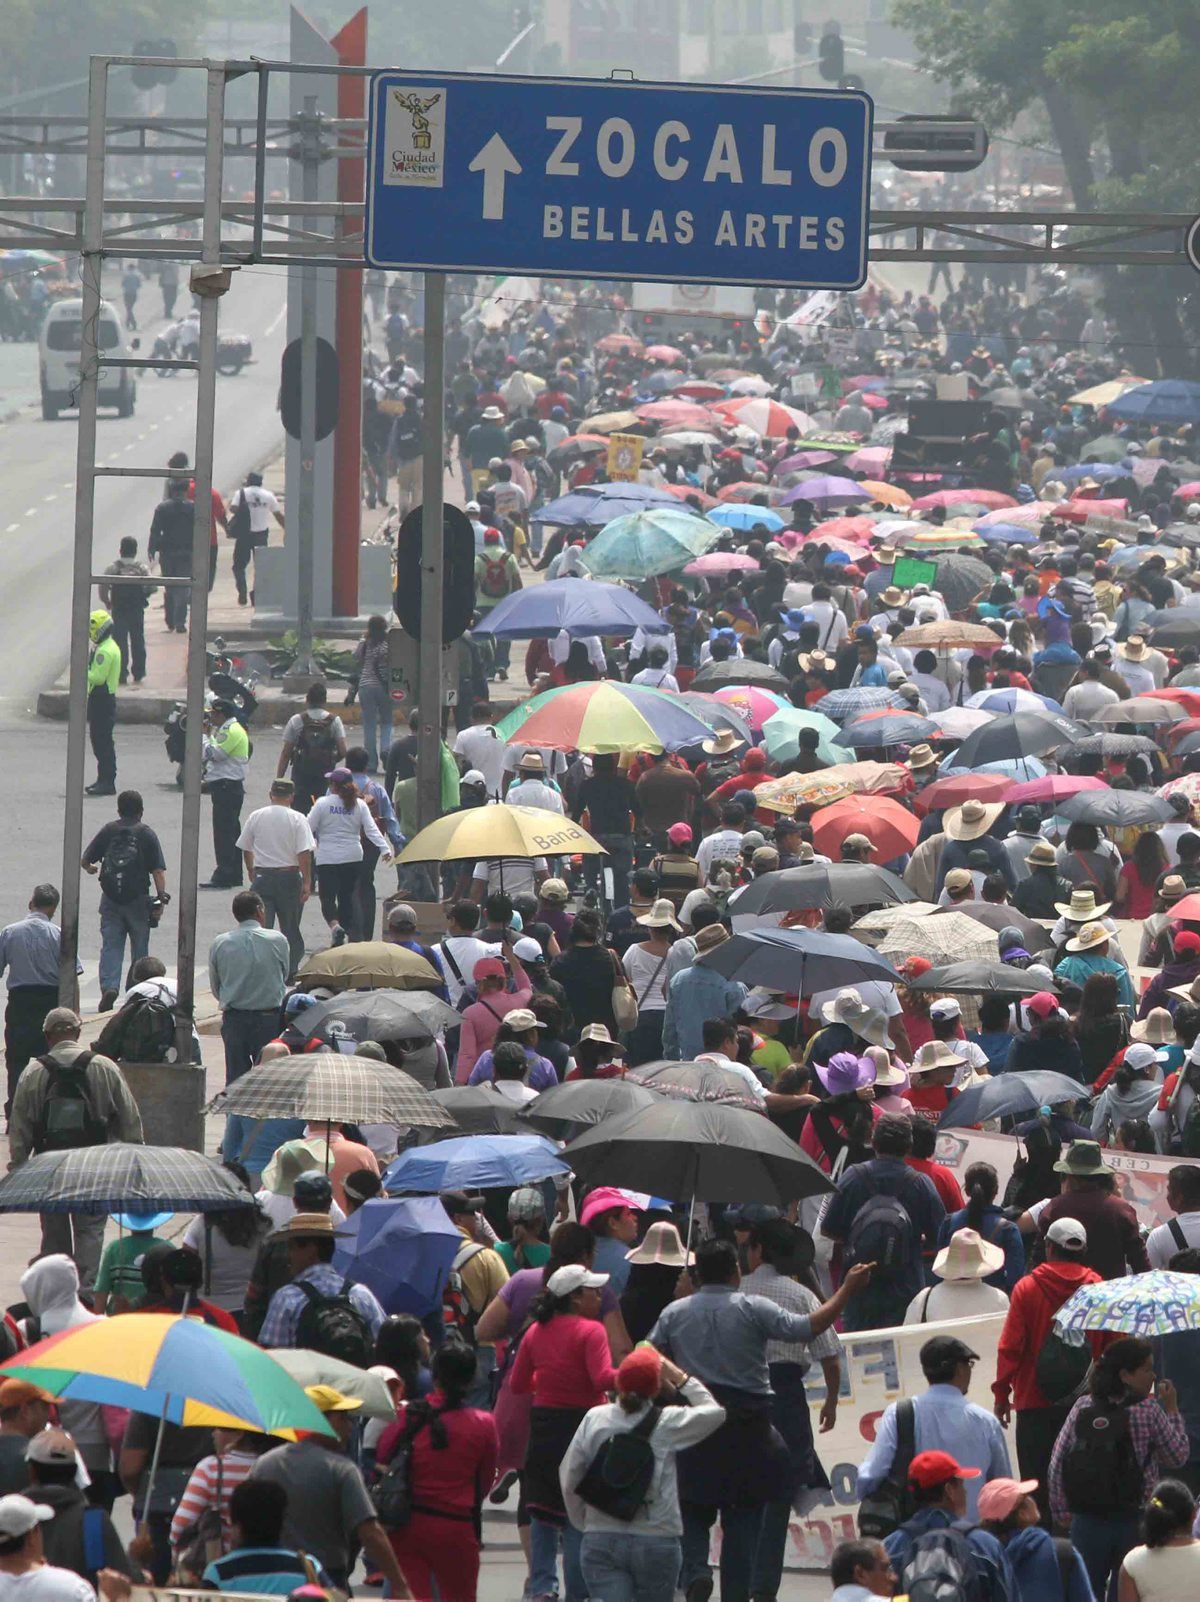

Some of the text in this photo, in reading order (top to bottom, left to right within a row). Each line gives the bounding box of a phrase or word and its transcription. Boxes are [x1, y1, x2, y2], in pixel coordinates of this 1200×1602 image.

[392, 150, 436, 163] Ciudad
[544, 115, 849, 188] ZOCALO
[543, 203, 846, 252] BELLAS ARTES
[532, 827, 583, 850] Bana
